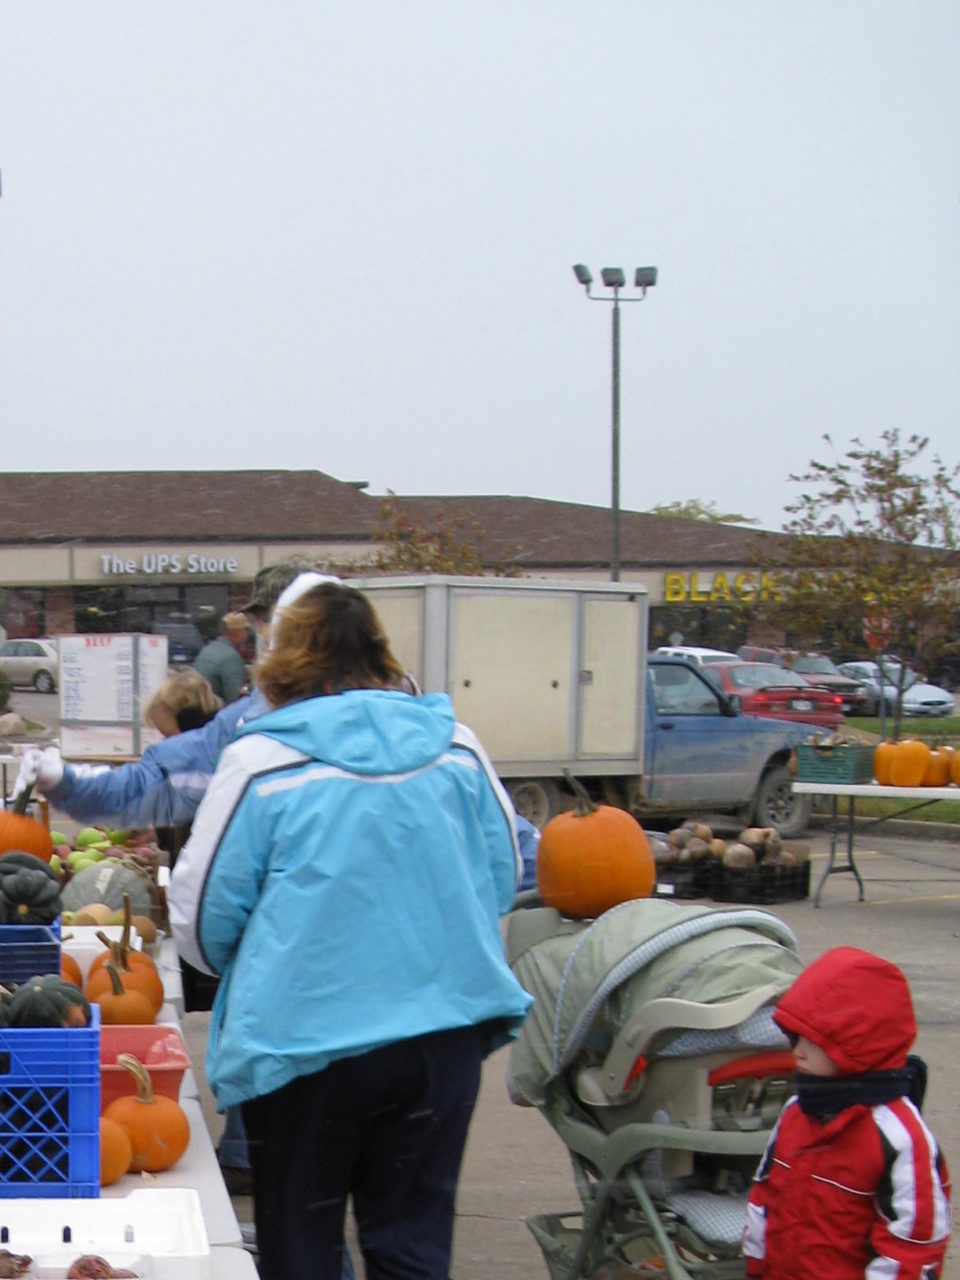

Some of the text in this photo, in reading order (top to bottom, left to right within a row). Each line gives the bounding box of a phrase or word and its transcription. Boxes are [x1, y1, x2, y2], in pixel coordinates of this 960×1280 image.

[101, 553, 239, 574] The UPS Store
